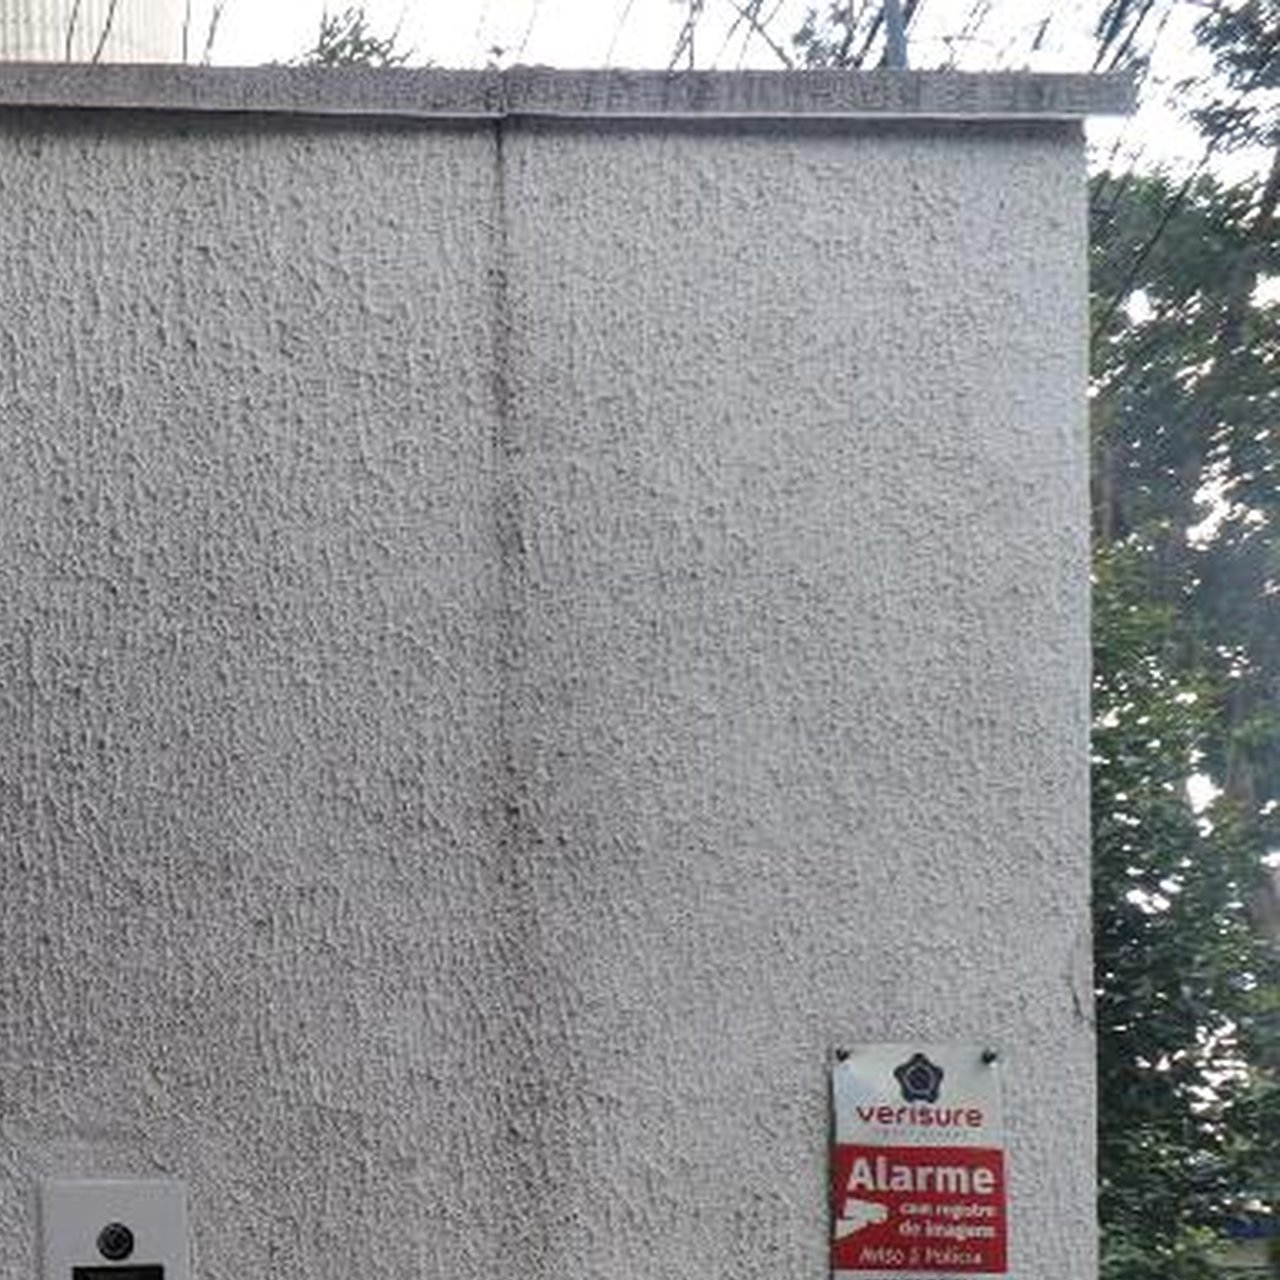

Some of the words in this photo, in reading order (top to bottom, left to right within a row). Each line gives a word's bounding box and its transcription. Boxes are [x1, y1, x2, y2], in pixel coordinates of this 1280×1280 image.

[856, 1104, 984, 1128] verisure
[846, 1156, 996, 1195] Alarme
[898, 1219, 921, 1234] de
